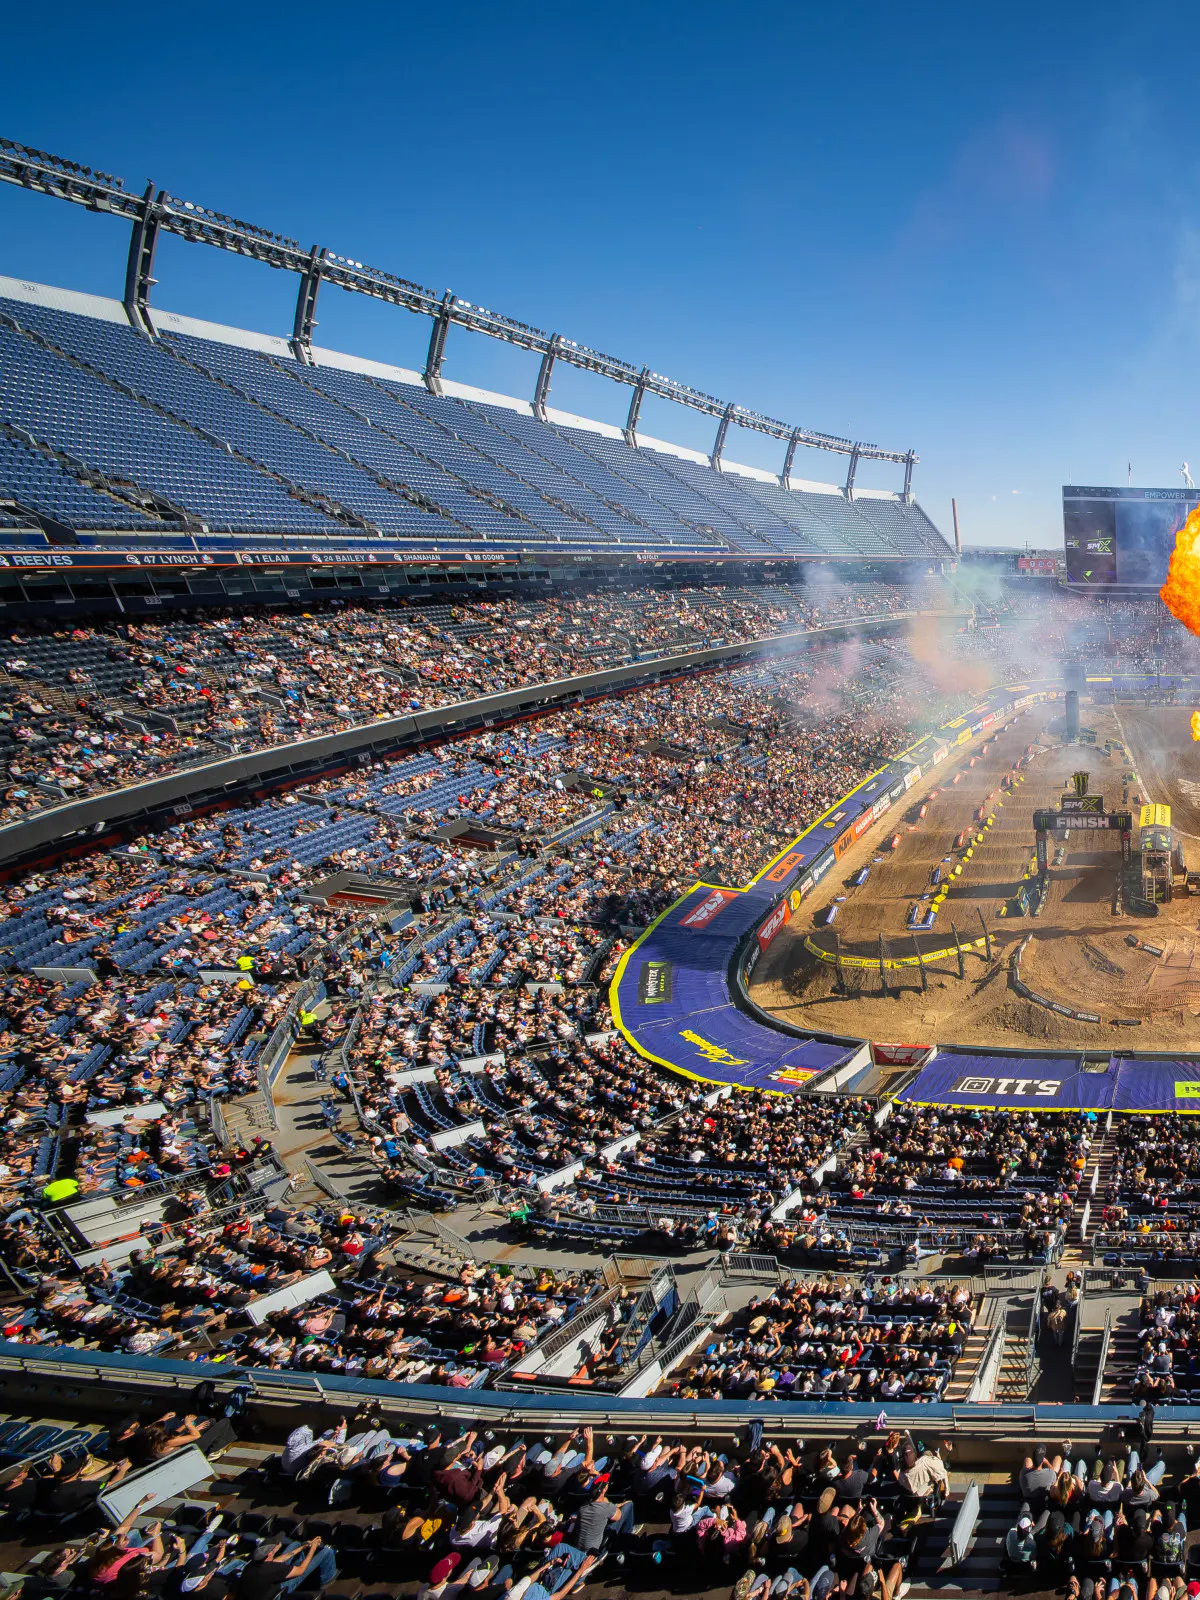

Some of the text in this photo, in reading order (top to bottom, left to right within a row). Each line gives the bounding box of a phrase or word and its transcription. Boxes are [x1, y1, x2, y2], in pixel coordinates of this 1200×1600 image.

[1144, 491, 1186, 499] EMPOWER
[12, 554, 73, 566] REEVES
[143, 555, 198, 564] 47 LYNCH
[255, 555, 260, 563] 1
[174, 804, 190, 814] 119
[1063, 799, 1098, 811] SMX
[1056, 816, 1109, 828] FINISH
[838, 834, 852, 854] KTM
[786, 855, 799, 865] KTM
[773, 867, 786, 879] KTM
[646, 969, 659, 997] MONSTER
[994, 1078, 1060, 1096] 5.11
